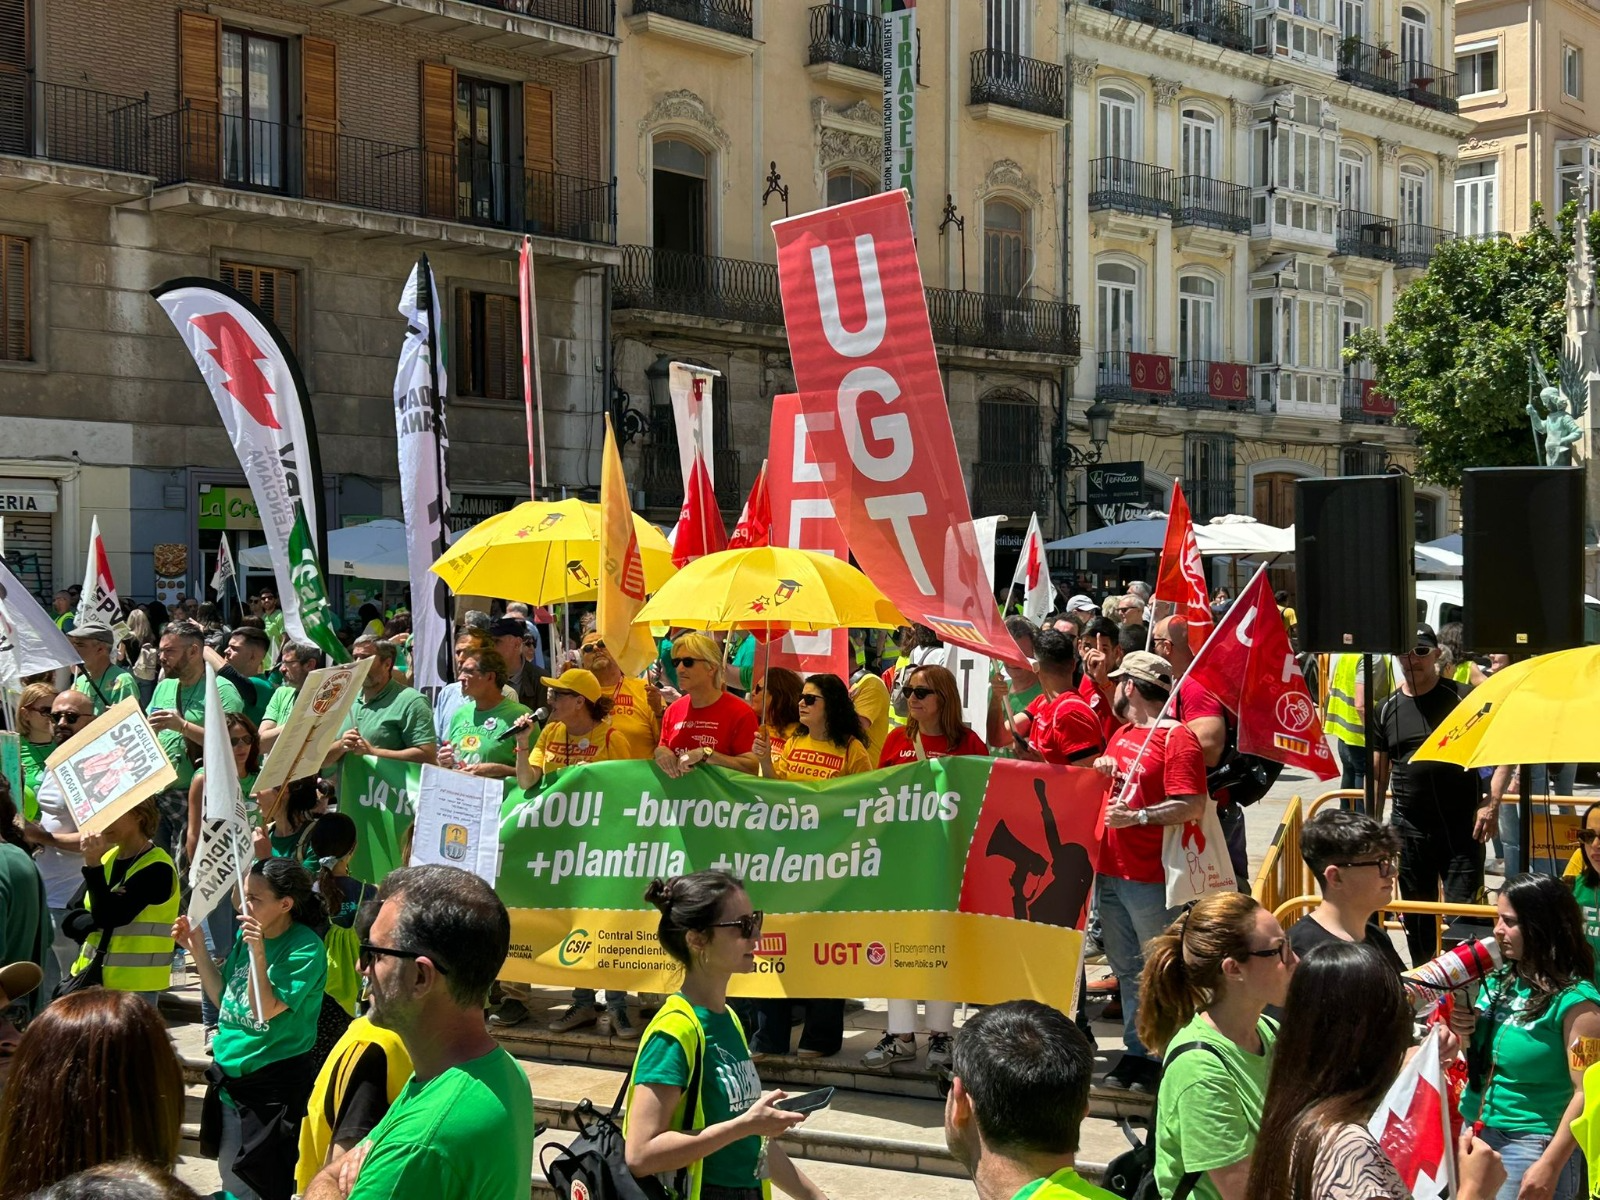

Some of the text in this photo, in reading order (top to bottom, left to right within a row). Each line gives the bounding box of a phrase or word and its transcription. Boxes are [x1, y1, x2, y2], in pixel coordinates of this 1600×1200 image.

[884, 18, 892, 59] AMBIENTE
[884, 61, 892, 87] MEDIO
[810, 232, 936, 596] UGT
[1104, 472, 1139, 484] Terrazza
[198, 498, 222, 517] La
[110, 723, 153, 783] SALIDA
[134, 724, 159, 763] CASILLA DE
[791, 751, 825, 764] CCOO
[59, 766, 76, 793] RECOGE
[72, 790, 83, 805] TUS
[359, 776, 389, 811] JA
[623, 791, 819, 831] -burocràcia
[843, 783, 961, 827] -ràtios
[527, 841, 686, 885] +plantilla
[566, 939, 592, 954] CSIF
[598, 929, 633, 941] Central
[509, 944, 533, 952] NDICAL
[813, 943, 862, 966] UGT
[598, 959, 677, 971] de Funcionarios
[935, 960, 948, 968] PV
